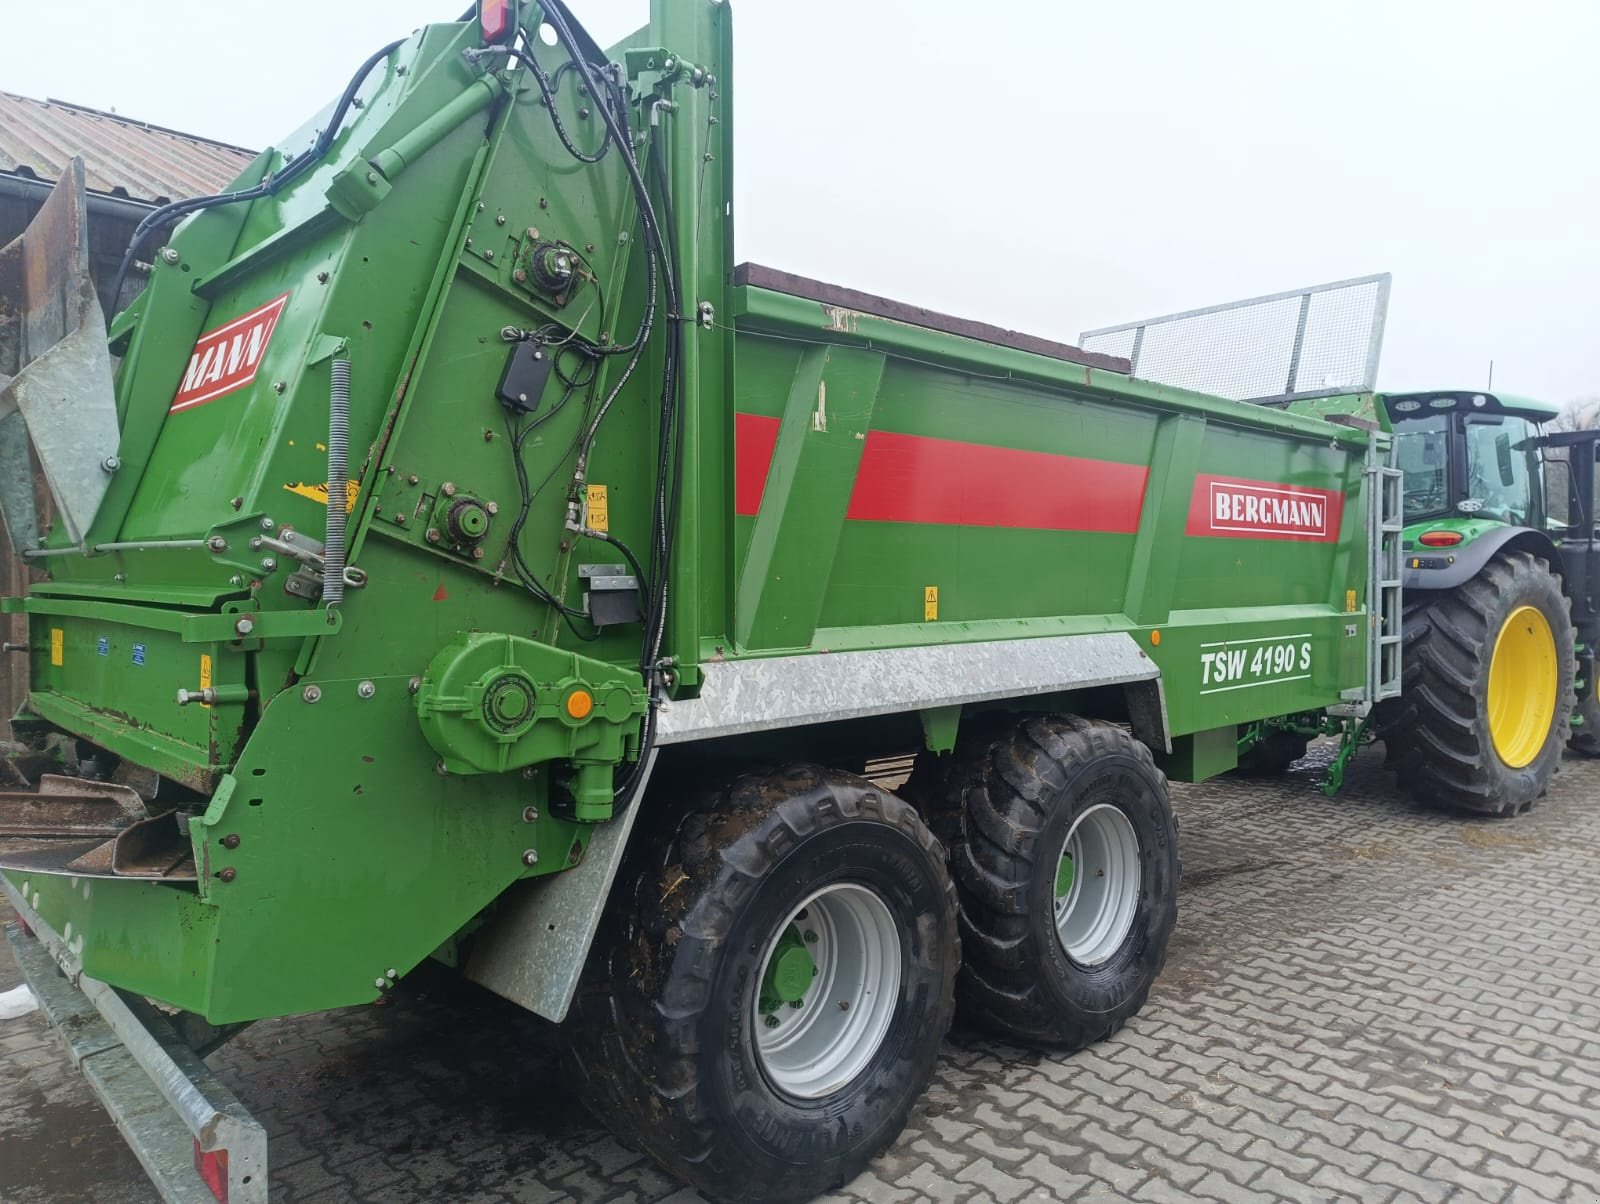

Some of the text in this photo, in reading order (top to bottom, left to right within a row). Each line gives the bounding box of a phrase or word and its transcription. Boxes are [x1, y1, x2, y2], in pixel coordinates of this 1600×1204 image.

[178, 318, 272, 394] MANN
[1215, 491, 1322, 528] BERGMANN
[1201, 642, 1312, 685] TSW 4190 S
